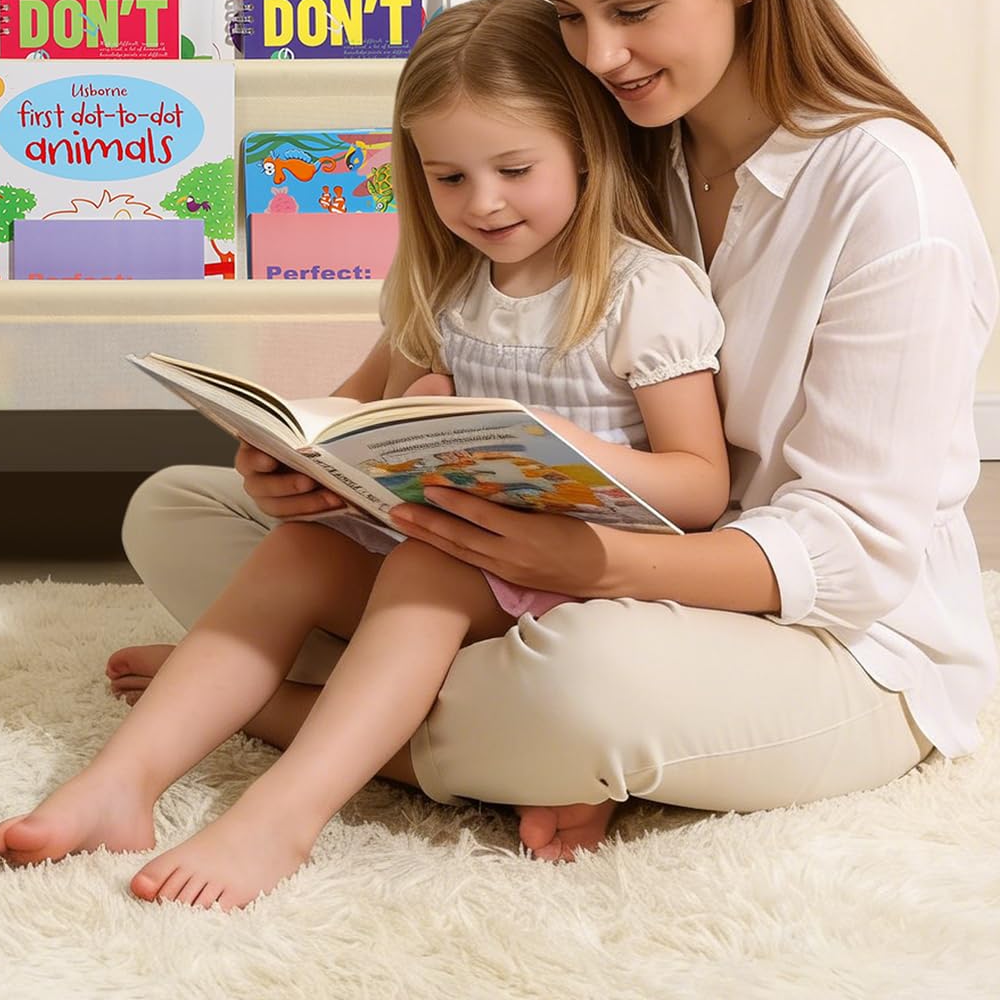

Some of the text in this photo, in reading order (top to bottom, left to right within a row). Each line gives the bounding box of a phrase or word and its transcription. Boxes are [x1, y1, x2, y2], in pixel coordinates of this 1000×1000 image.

[71, 83, 128, 97] Usborne
[18, 100, 184, 128] first dot-to-dot
[25, 128, 174, 165] animals
[266, 265, 371, 280] Perfect:
